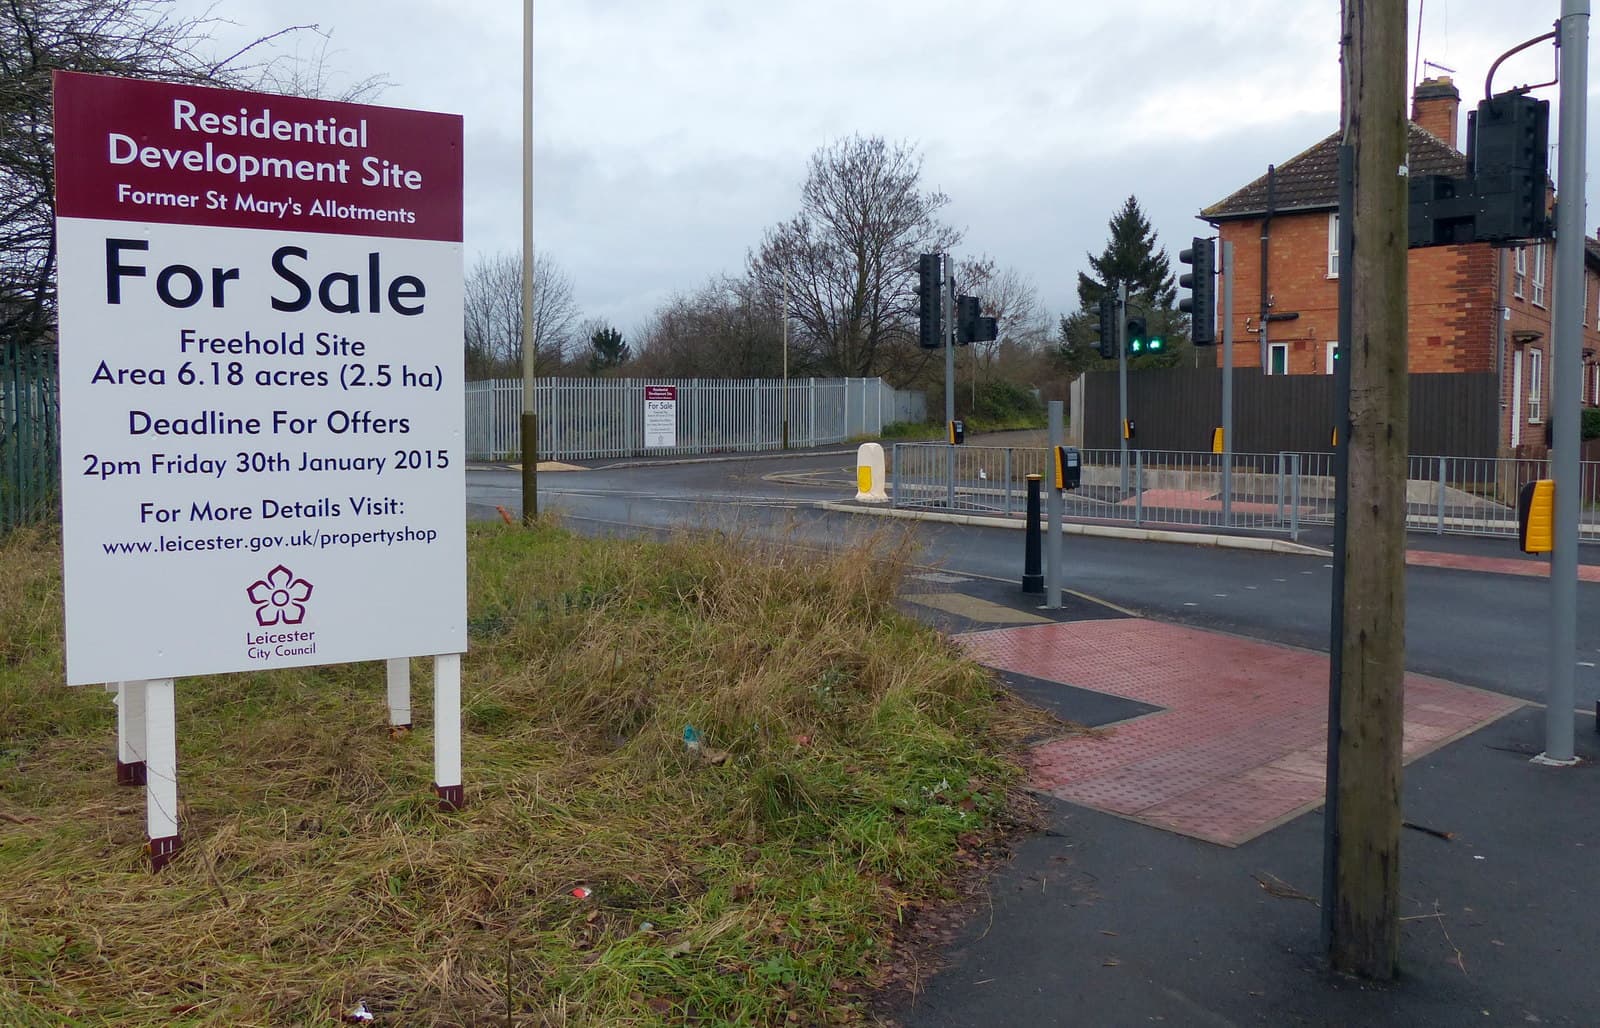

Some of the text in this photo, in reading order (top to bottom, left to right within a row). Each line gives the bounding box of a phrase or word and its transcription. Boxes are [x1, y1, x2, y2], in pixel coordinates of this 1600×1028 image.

[174, 99, 368, 148] Residential
[109, 133, 422, 190] Development Site
[118, 184, 416, 224] Former St Mary's Allotments
[105, 237, 426, 316] For Sale
[180, 329, 366, 357] Freehold Site
[91, 360, 443, 391] Area 6.18 acres (2.5 ha)
[129, 410, 410, 435] Deadline For Offers
[83, 449, 449, 481] 2pm Friday 30th January 2015
[140, 496, 404, 523] For More Details Visit:
[103, 526, 437, 555] www.leicester.gov.uk/propertyshop
[246, 630, 316, 645] Leicester
[247, 643, 316, 660] City Council
